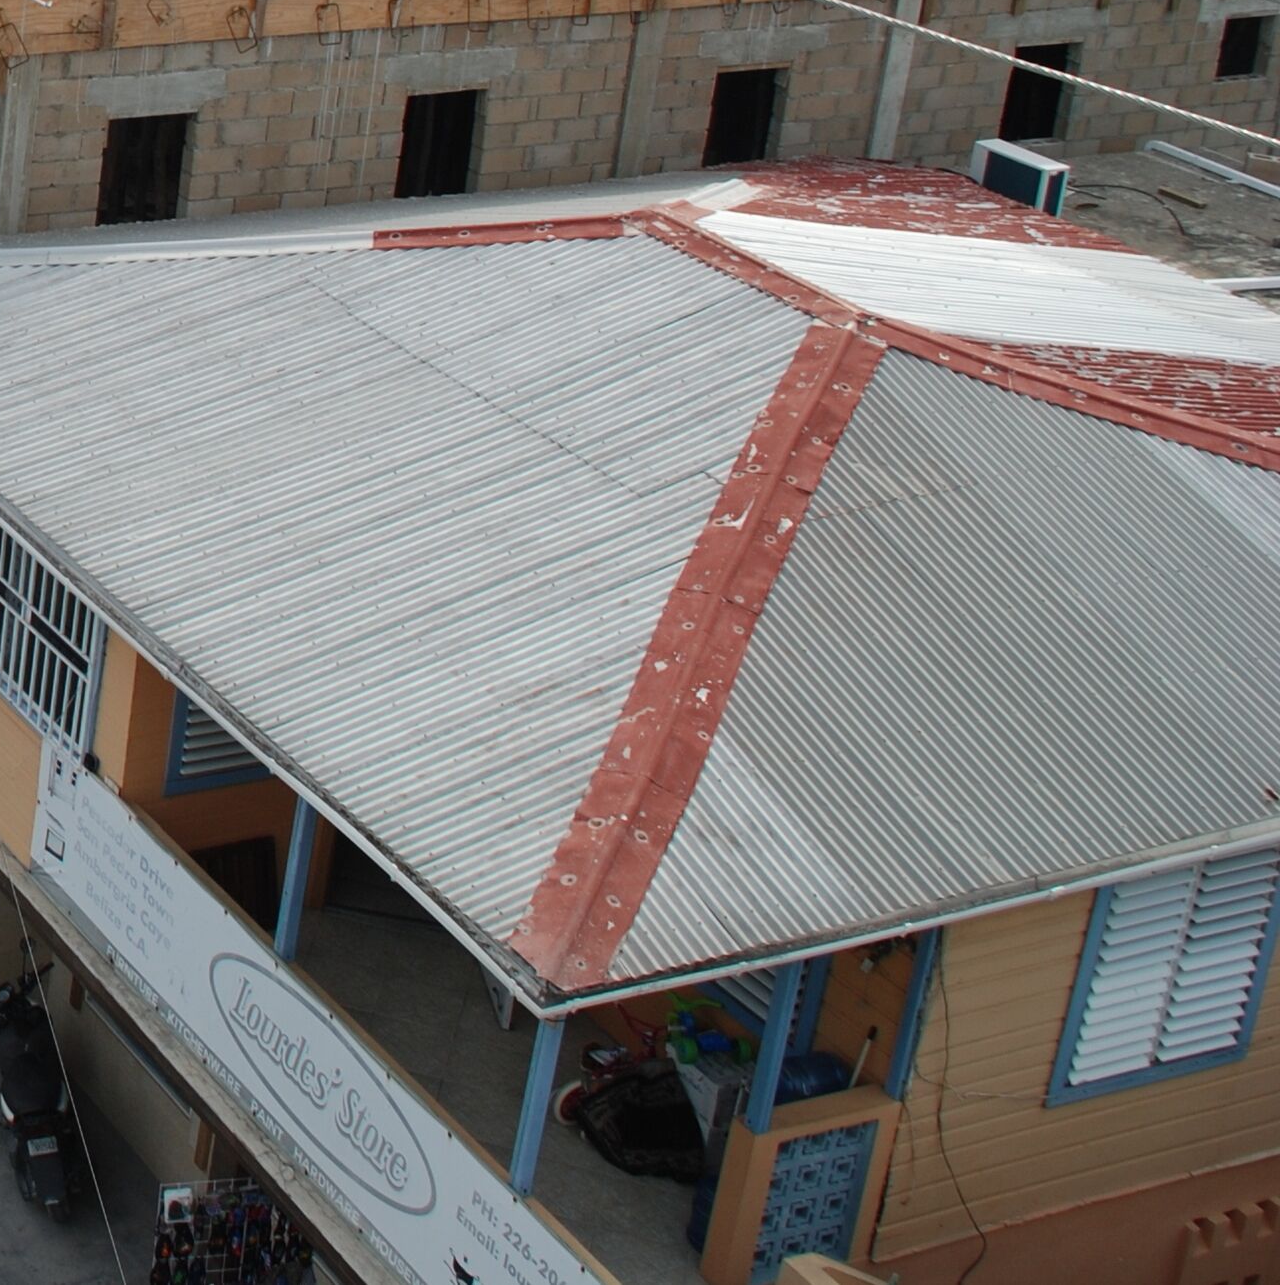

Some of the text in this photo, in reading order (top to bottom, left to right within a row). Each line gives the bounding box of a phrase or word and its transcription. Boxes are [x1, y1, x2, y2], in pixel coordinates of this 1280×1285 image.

[72, 840, 172, 951] Ambergris Caye
[76, 816, 176, 927] San Pedro Town
[81, 795, 175, 900] Pescador Drive
[85, 880, 123, 931] Belize
[105, 944, 159, 1006] FURNITURE
[166, 1008, 242, 1098] KITCHENWARE
[250, 1099, 284, 1141] PAINT
[292, 1146, 362, 1226] HARDWARE
[229, 976, 409, 1192] Lourdes' Store
[455, 1205, 532, 1285] Email: lou
[471, 1190, 567, 1285] PH: 226-20
